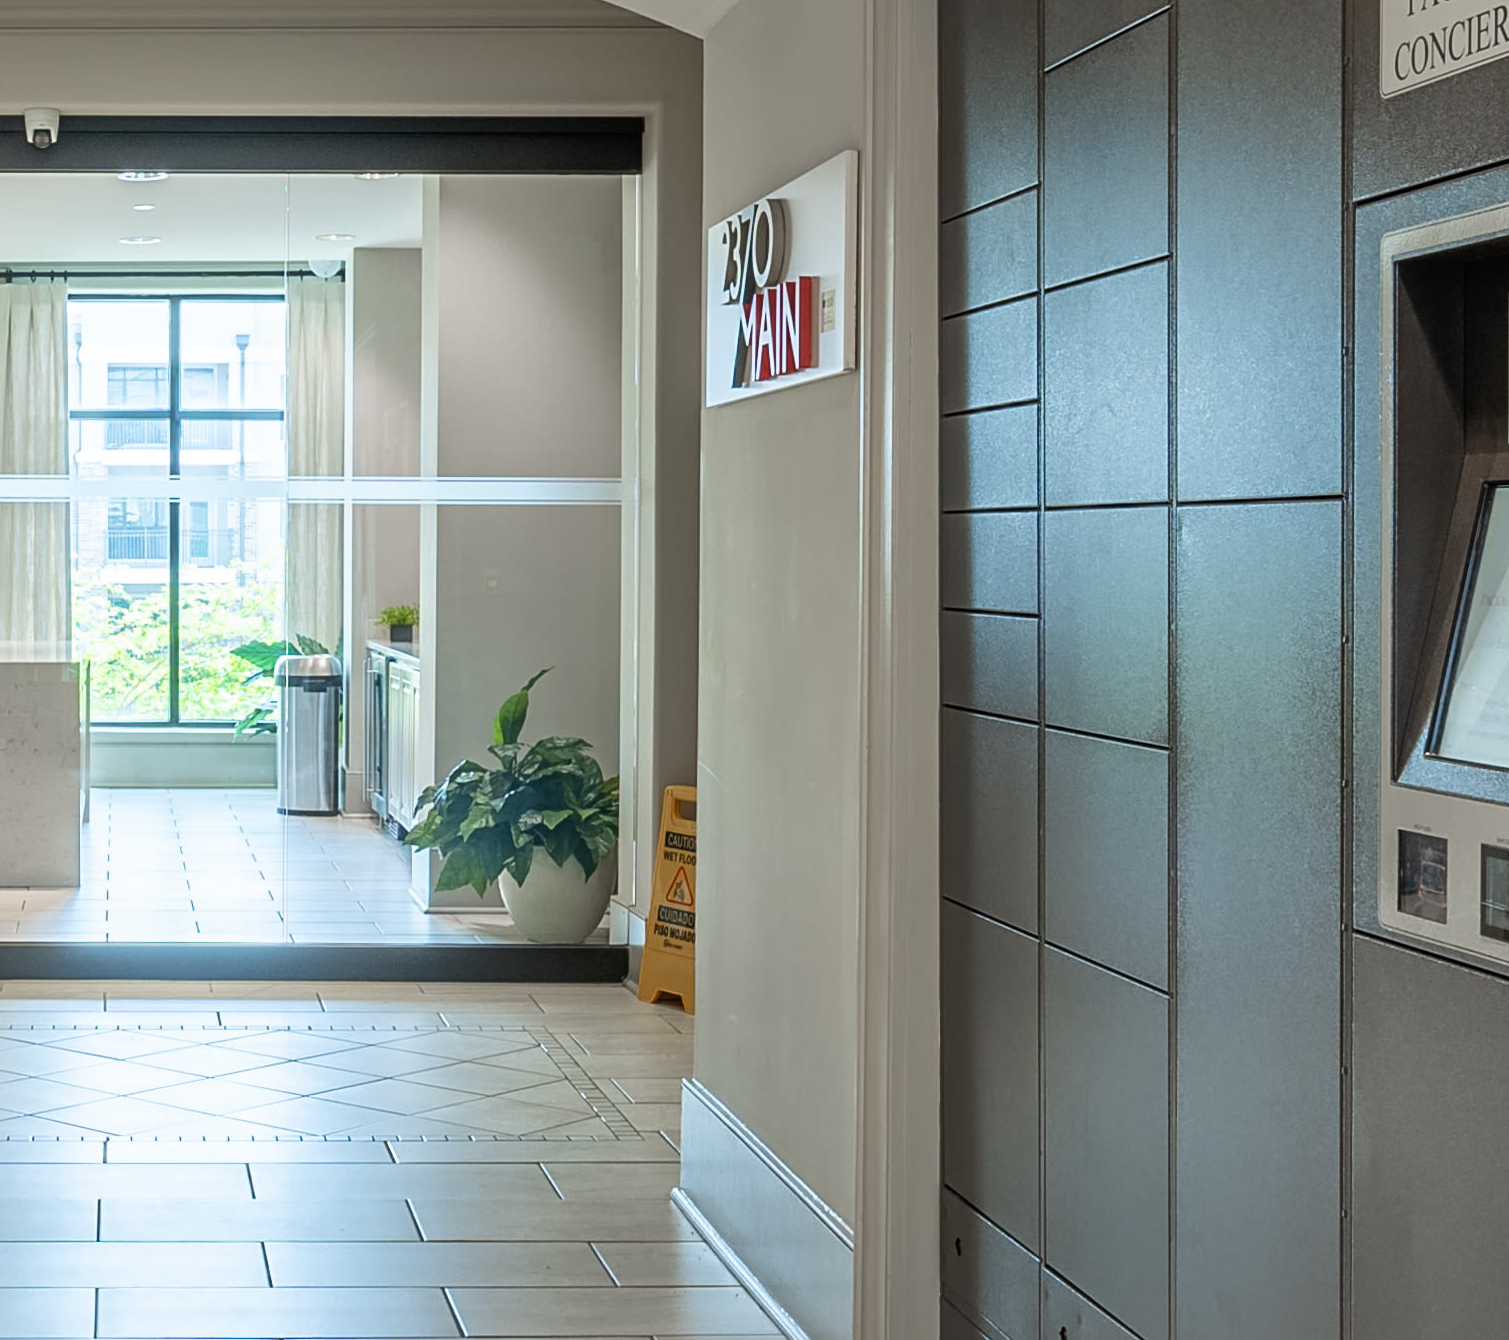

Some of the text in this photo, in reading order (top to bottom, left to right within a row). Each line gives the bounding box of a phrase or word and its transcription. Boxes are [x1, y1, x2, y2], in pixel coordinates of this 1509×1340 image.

[740, 274, 812, 382] MAIN
[667, 833, 696, 851] CAUTIO
[663, 850, 697, 867] WET FLOO
[659, 907, 694, 926] CUIDADO
[654, 923, 669, 937] PISO
